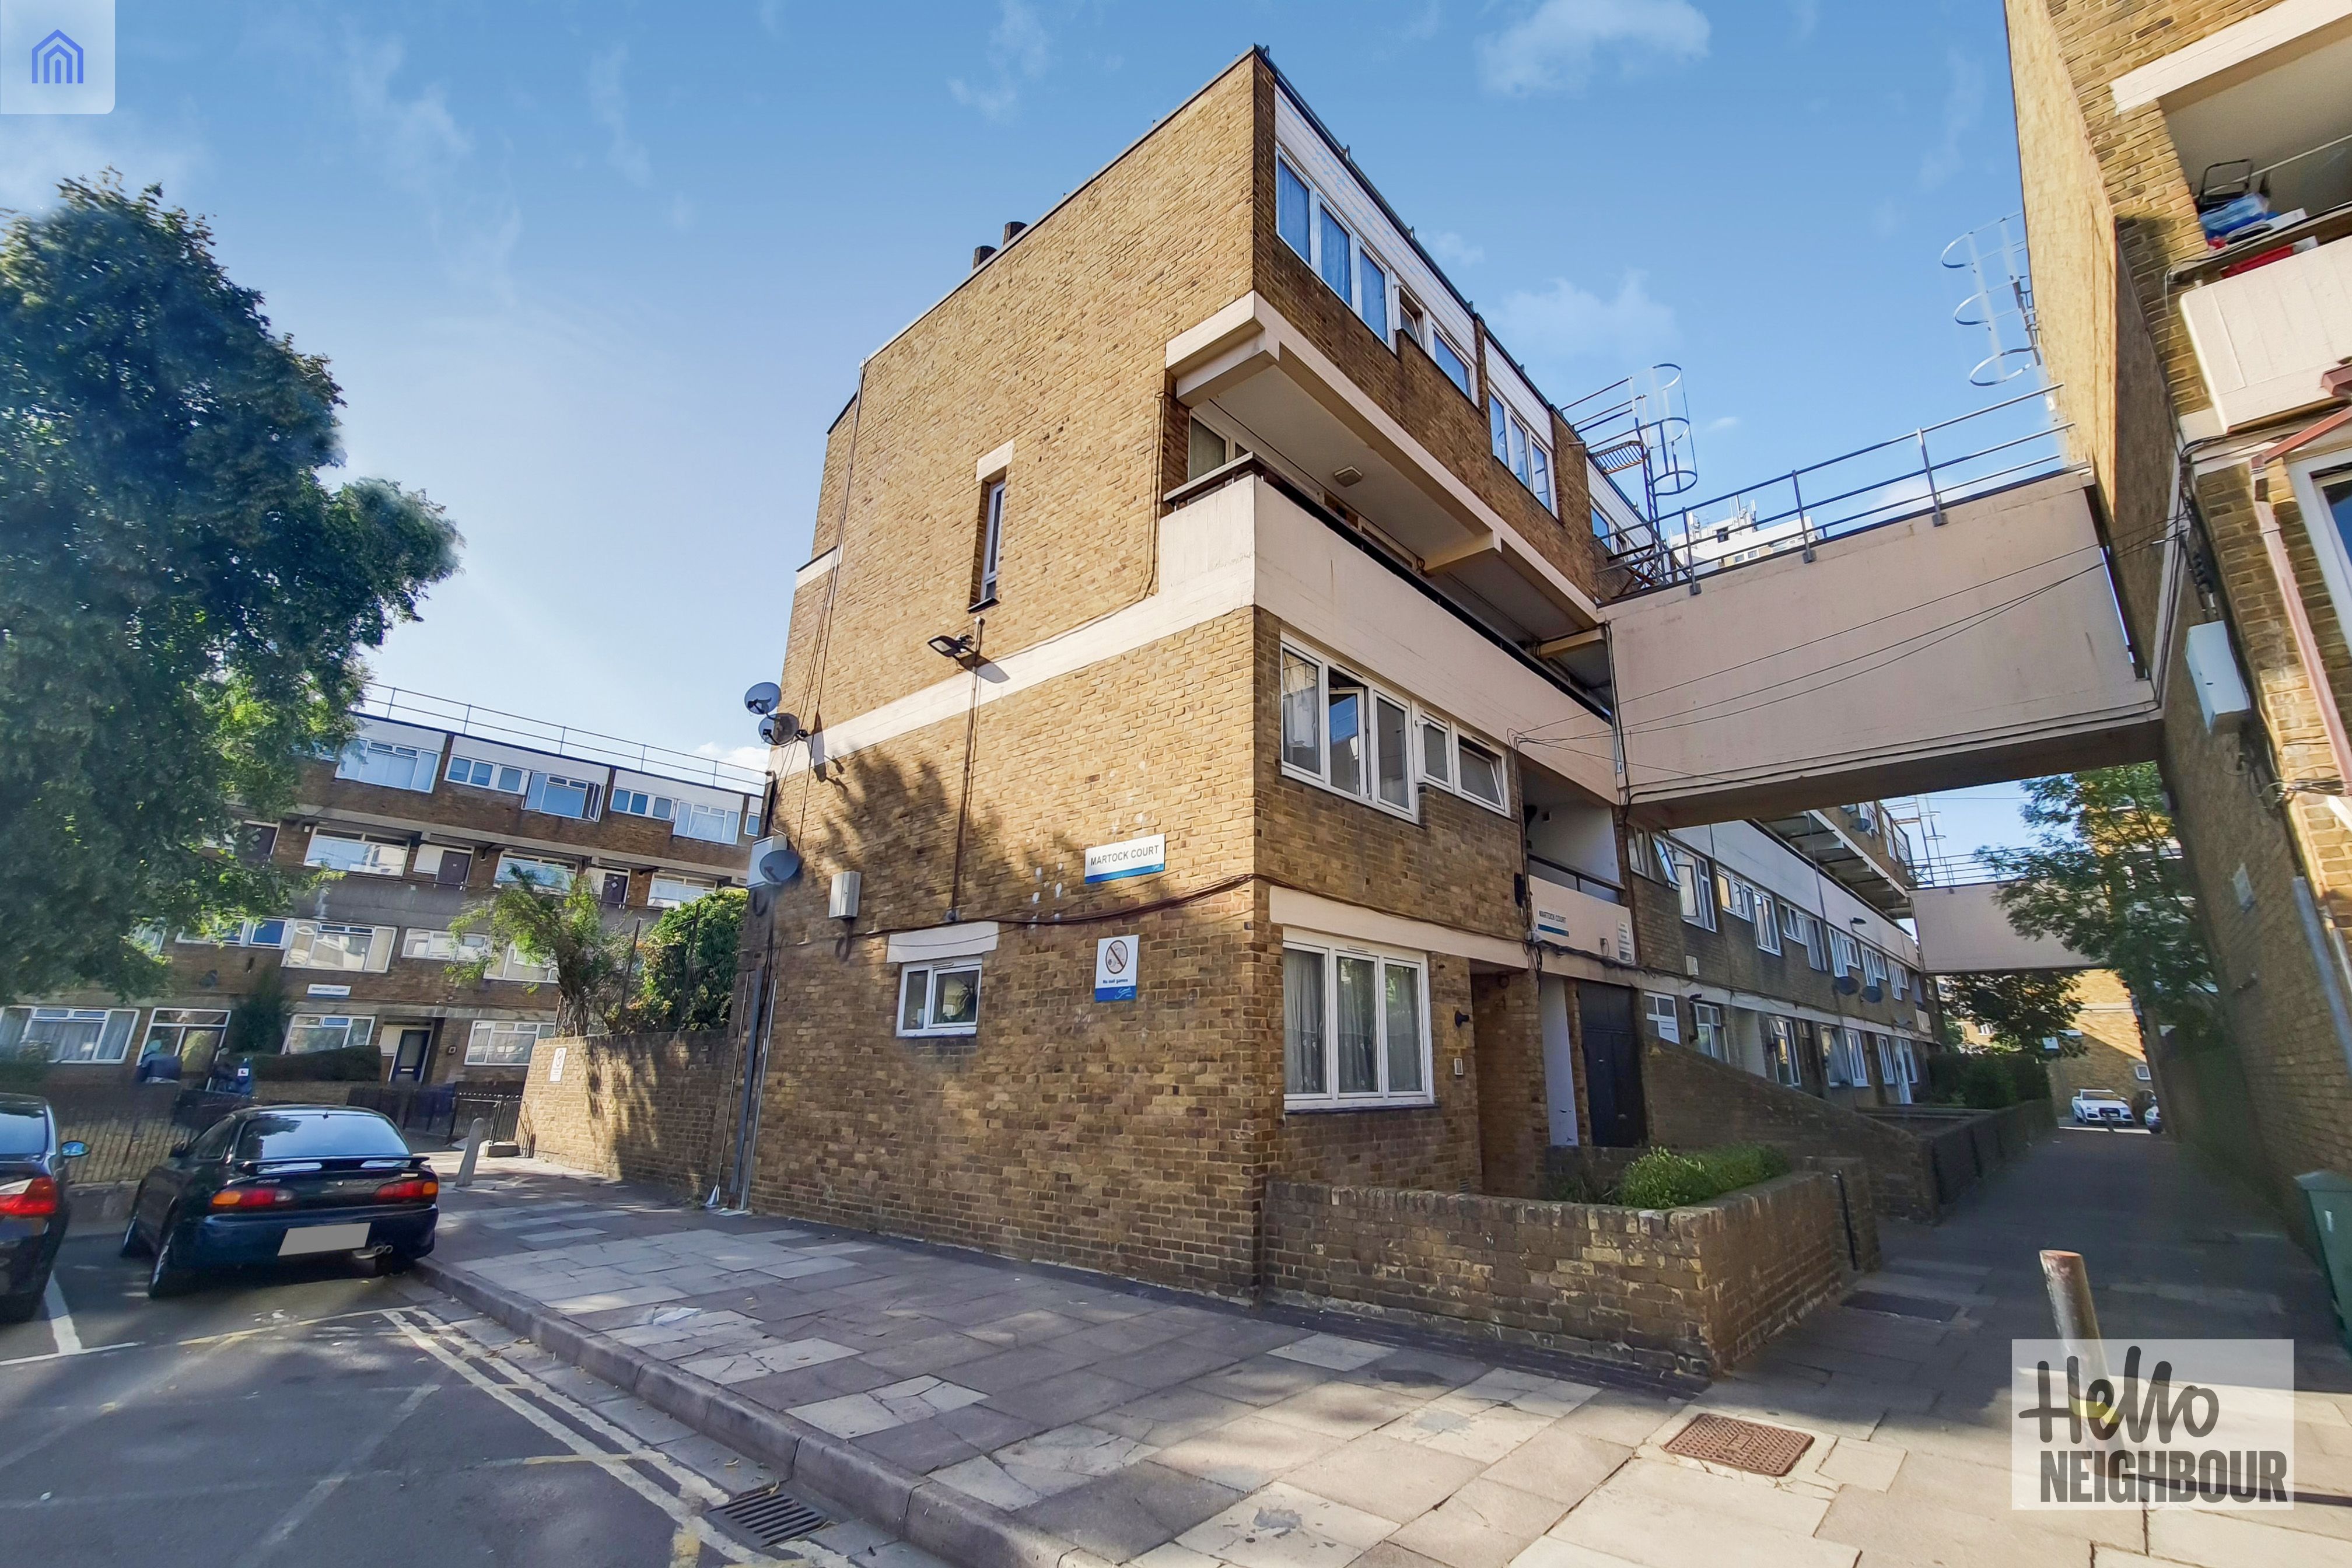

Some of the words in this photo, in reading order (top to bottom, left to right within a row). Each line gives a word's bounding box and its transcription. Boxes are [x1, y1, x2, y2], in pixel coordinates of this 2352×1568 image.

[1090, 850, 1129, 866] MARTOCK
[1130, 845, 1159, 859] COURT
[1539, 910, 1555, 921] MARTOCK
[1555, 915, 1567, 923] COURT
